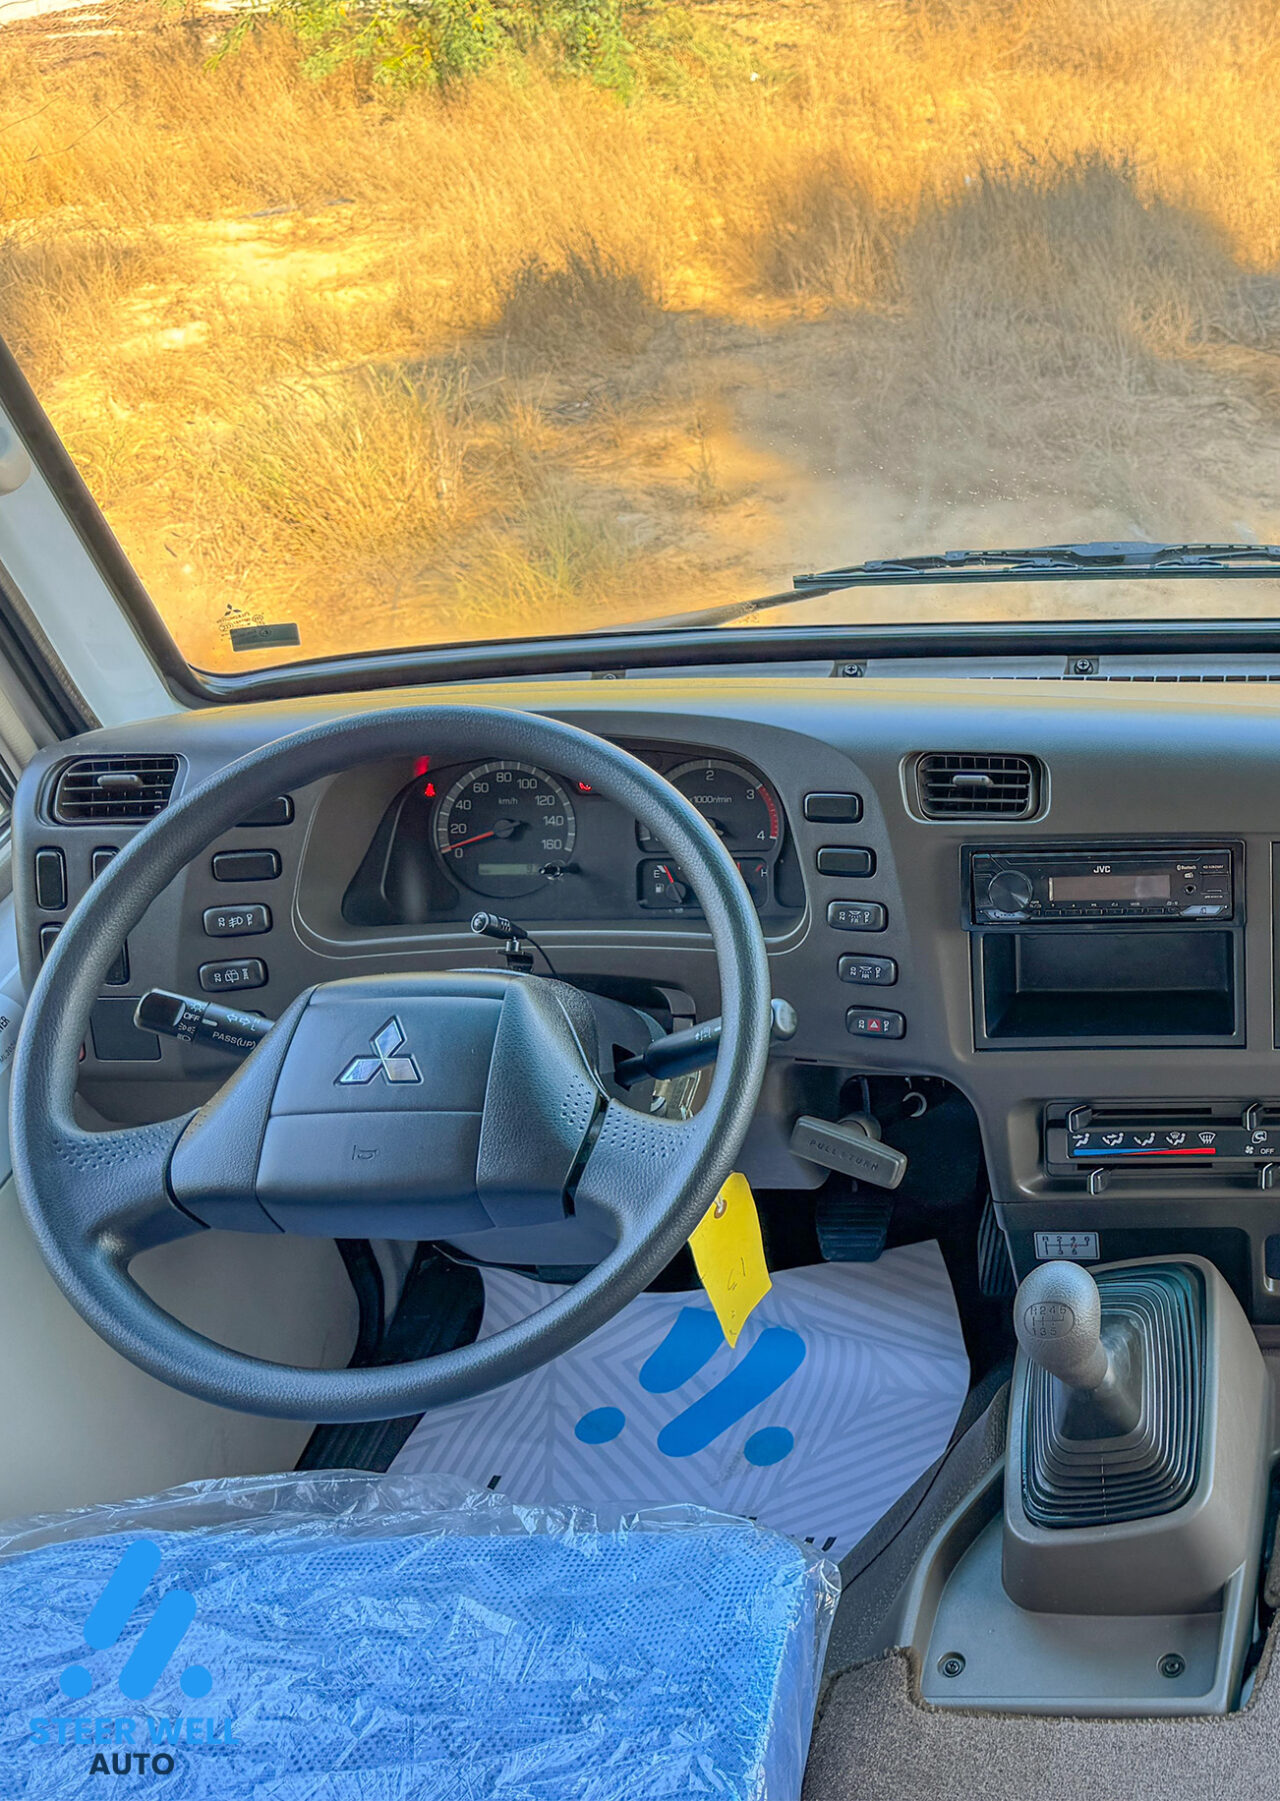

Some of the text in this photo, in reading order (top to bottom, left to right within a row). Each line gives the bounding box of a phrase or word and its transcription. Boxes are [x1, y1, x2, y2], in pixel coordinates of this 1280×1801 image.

[496, 772, 513, 783] 80
[705, 769, 714, 781] 2
[473, 782, 490, 793] 60
[517, 778, 538, 790] 100
[746, 789, 755, 800] 3
[455, 800, 472, 810] 40
[535, 795, 556, 806] 120
[543, 815, 565, 826] 140
[450, 823, 467, 834] 20
[756, 830, 766, 841] 4
[541, 839, 563, 850] 160
[454, 848, 464, 859] 0
[653, 870, 661, 879] E
[760, 868, 768, 877] H
[1093, 865, 1111, 874] JVC
[183, 1012, 200, 1022] OFF
[212, 1031, 257, 1050] PASS(UP)
[808, 1139, 837, 1156] PULL
[1260, 1147, 1275, 1155] OFF
[1039, 1305, 1047, 1315] 2
[1039, 1327, 1047, 1336] 3
